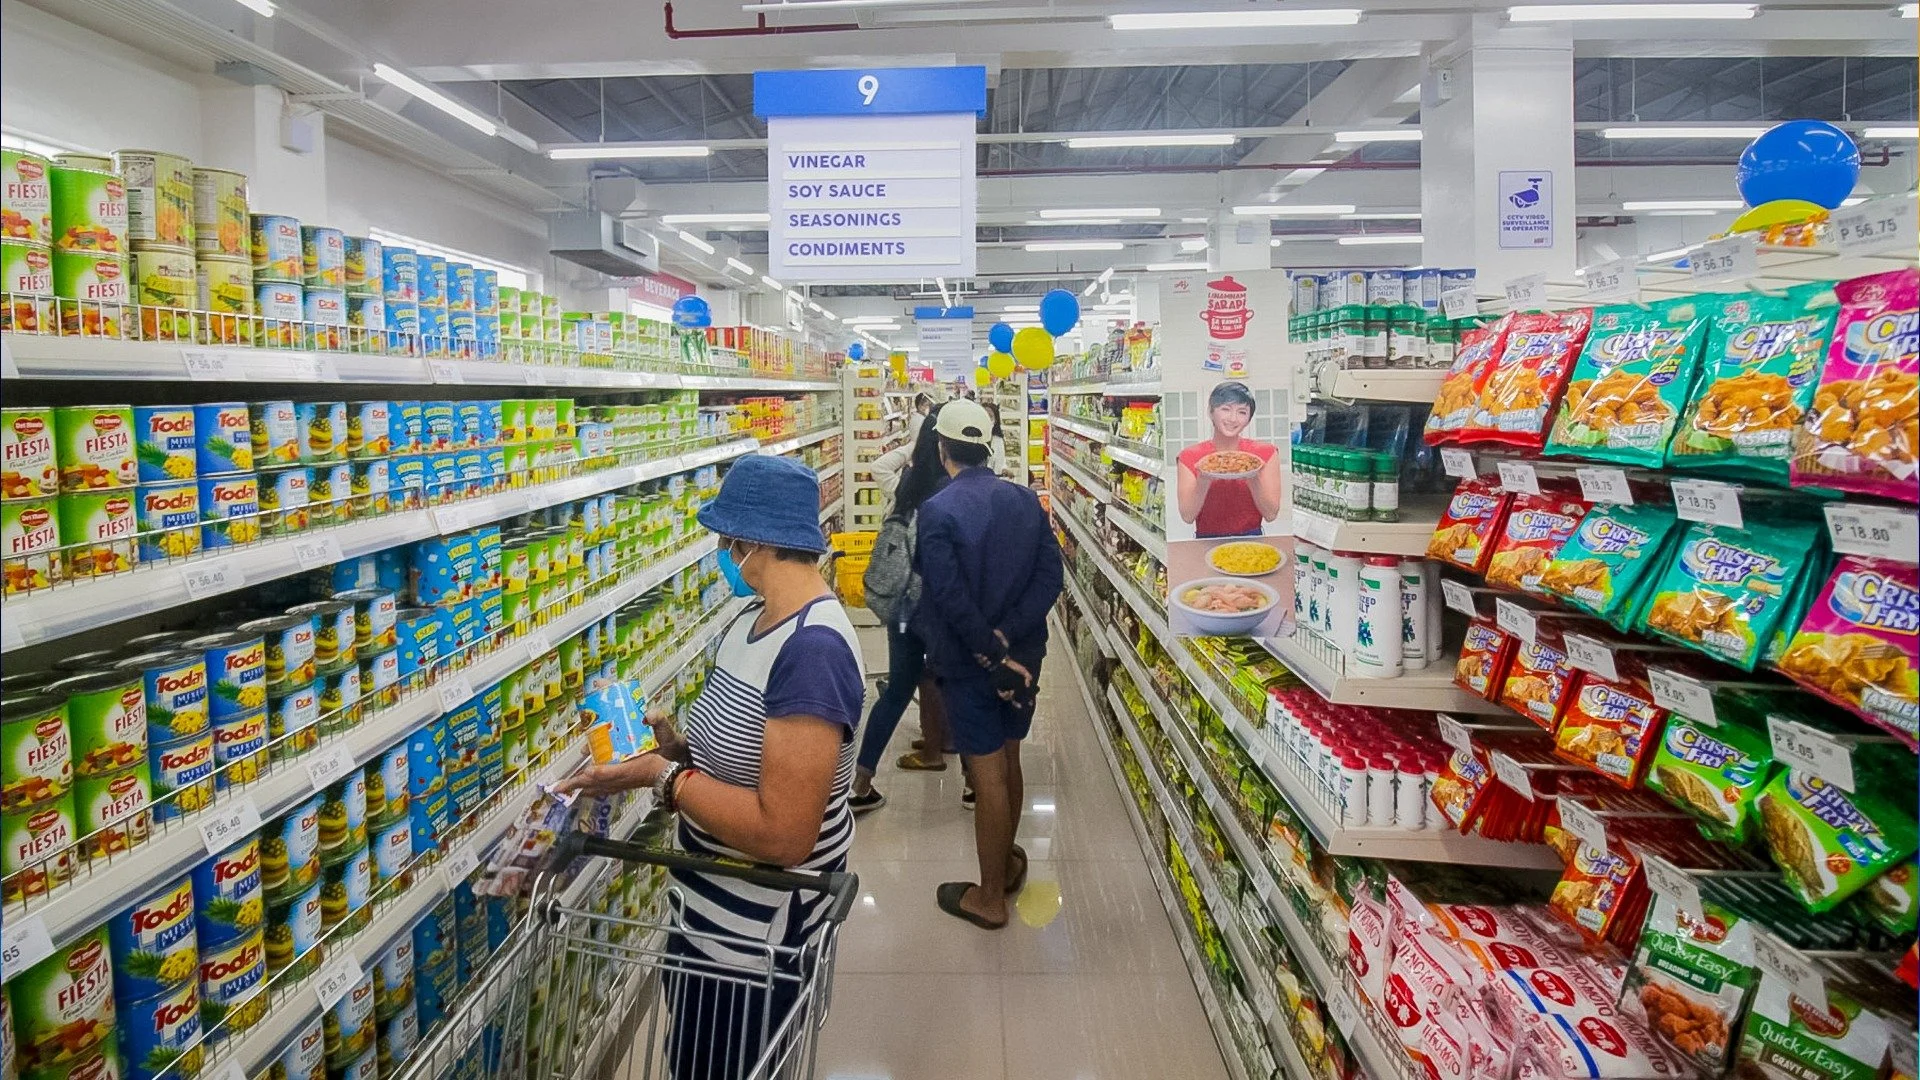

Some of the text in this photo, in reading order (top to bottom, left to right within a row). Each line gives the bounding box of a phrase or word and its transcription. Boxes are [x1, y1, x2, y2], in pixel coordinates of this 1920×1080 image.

[858, 75, 879, 105] 9
[788, 155, 866, 168] VINEGAR
[8, 184, 48, 199] FIESTA
[788, 184, 887, 198] SOY SAUCE
[789, 213, 902, 227] SEASONINGS
[1841, 229, 1849, 240] P
[1855, 218, 1898, 239] 56.75
[788, 242, 906, 256] CONDIMENTS
[1693, 262, 1700, 272] P
[1703, 257, 1734, 271] 56.75
[88, 284, 126, 299] FIESTA
[1588, 280, 1594, 289] P
[1596, 275, 1619, 288] 56.75
[275, 292, 296, 304] Dole
[318, 299, 339, 310] Dole
[940, 308, 948, 317] 7
[6, 438, 50, 460] FIESTA
[86, 432, 129, 453] FIESTA
[1583, 481, 1588, 490] P
[1678, 495, 1716, 511] P 18.75
[98, 516, 135, 539] FIESTA
[1517, 510, 1565, 528] CRISPY
[12, 527, 55, 553] FIESTA
[1525, 525, 1550, 539] FRY
[1591, 518, 1651, 546] CRISPY
[1835, 524, 1891, 542] P 18.80
[1600, 541, 1625, 553] FRY
[1695, 541, 1775, 572] CRISPY
[189, 572, 225, 589] P 56.40
[1703, 561, 1749, 582] FRY
[1864, 601, 1920, 631] FRY
[1529, 643, 1568, 662] CRISPY
[1533, 657, 1556, 671] FRY
[1655, 682, 1661, 693] P
[1591, 685, 1646, 711] CRISPY
[115, 705, 146, 732] FIESTA
[1602, 705, 1627, 720] FRY
[28, 733, 68, 767] FIESTA
[1676, 726, 1744, 763] CRISPY
[1775, 734, 1814, 760] P 8.05
[1685, 748, 1727, 768] FRY
[313, 771, 318, 779] P
[102, 789, 144, 821] FIESTA
[1800, 771, 1876, 836] CRISPY
[1801, 795, 1849, 829] FRY
[207, 816, 241, 841] P 56.40
[19, 825, 67, 861] FIESTA
[1651, 933, 1738, 981] Quick Easy
[57, 958, 109, 1011] FIESTA
[322, 990, 327, 999] P
[1759, 1021, 1856, 1080] Quick Easy
[1771, 1053, 1804, 1075] GRAVY
